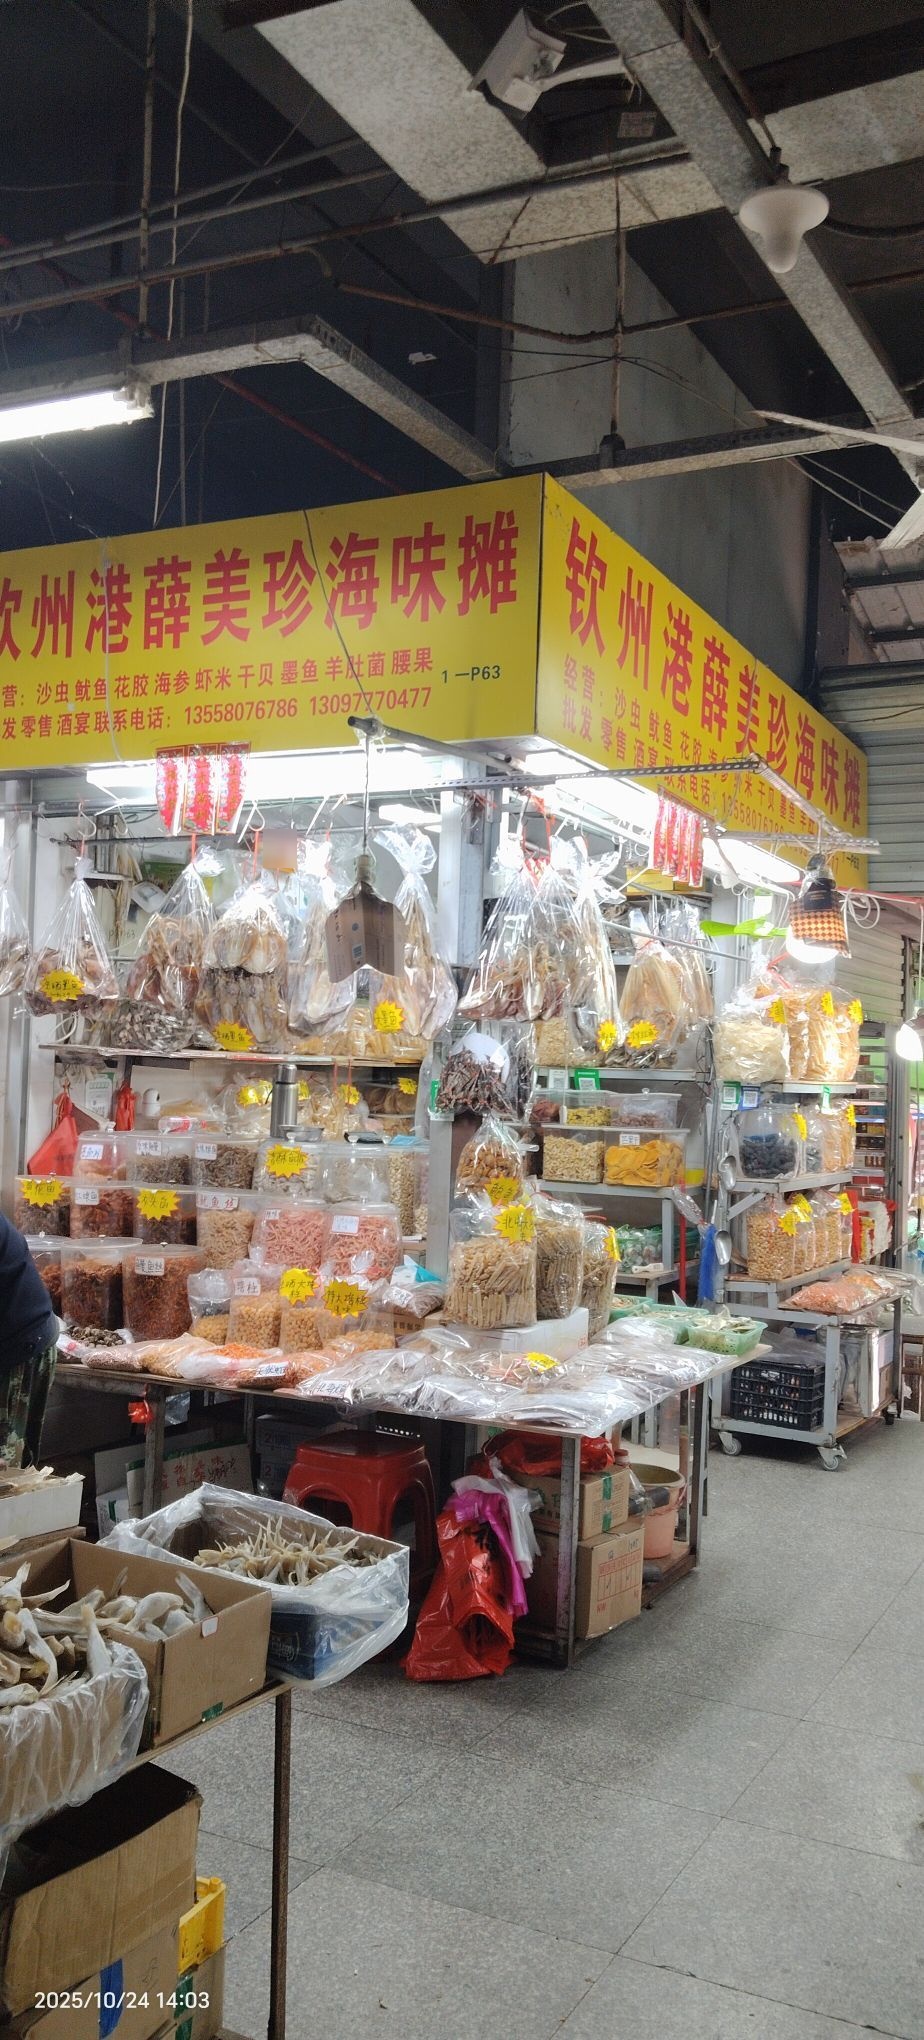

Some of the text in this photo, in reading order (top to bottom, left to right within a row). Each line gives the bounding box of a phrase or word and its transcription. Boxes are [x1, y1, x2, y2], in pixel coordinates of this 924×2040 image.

[36, 680, 69, 705] 沙虫
[75, 678, 107, 702] 鱿鱼
[114, 673, 149, 699] 花胶
[154, 669, 190, 696] 海参
[195, 666, 231, 692] 虾米
[238, 662, 273, 689] 干贝
[281, 658, 318, 684] 墨鱼
[325, 651, 385, 682] 羊肚菌
[391, 646, 433, 675] 腰果
[565, 516, 861, 828] 钦州港薛美珍海味摊
[21, 713, 52, 739] 零售
[184, 697, 298, 726] 13558076786
[310, 686, 432, 717] 13097770477
